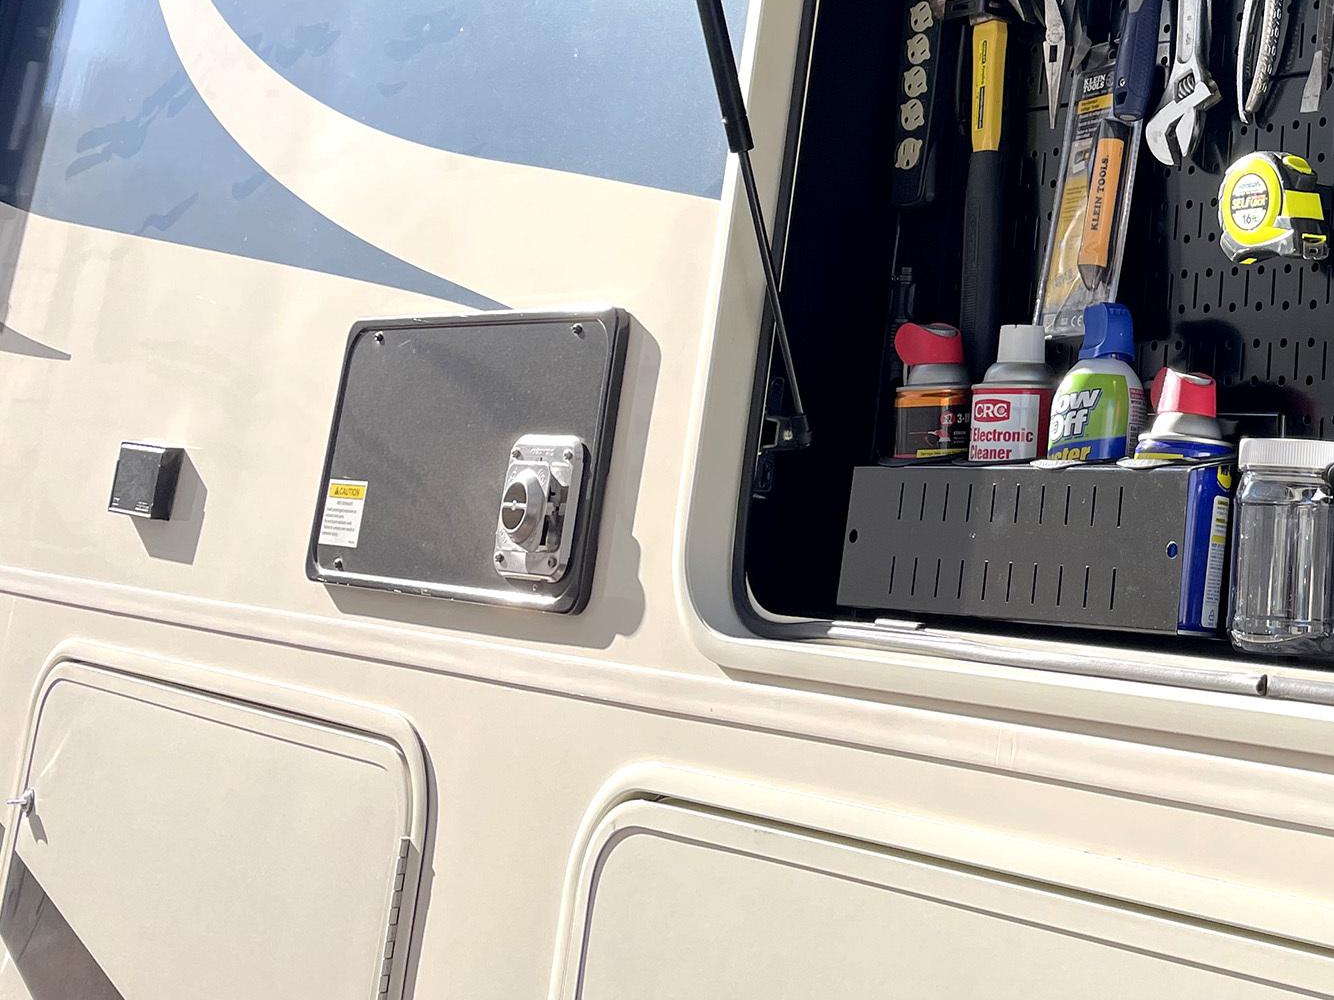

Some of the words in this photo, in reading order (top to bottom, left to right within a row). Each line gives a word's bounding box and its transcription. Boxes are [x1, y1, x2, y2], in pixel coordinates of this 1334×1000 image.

[1082, 80, 1105, 94] TOOLS
[1083, 74, 1106, 86] KLEIN
[1091, 196, 1103, 231] KLEIN
[975, 403, 1008, 418] CRC
[1050, 409, 1089, 442] Off
[973, 428, 1034, 443] Electronic
[970, 445, 1013, 460] Cleaner
[340, 487, 361, 497] CAUTION
